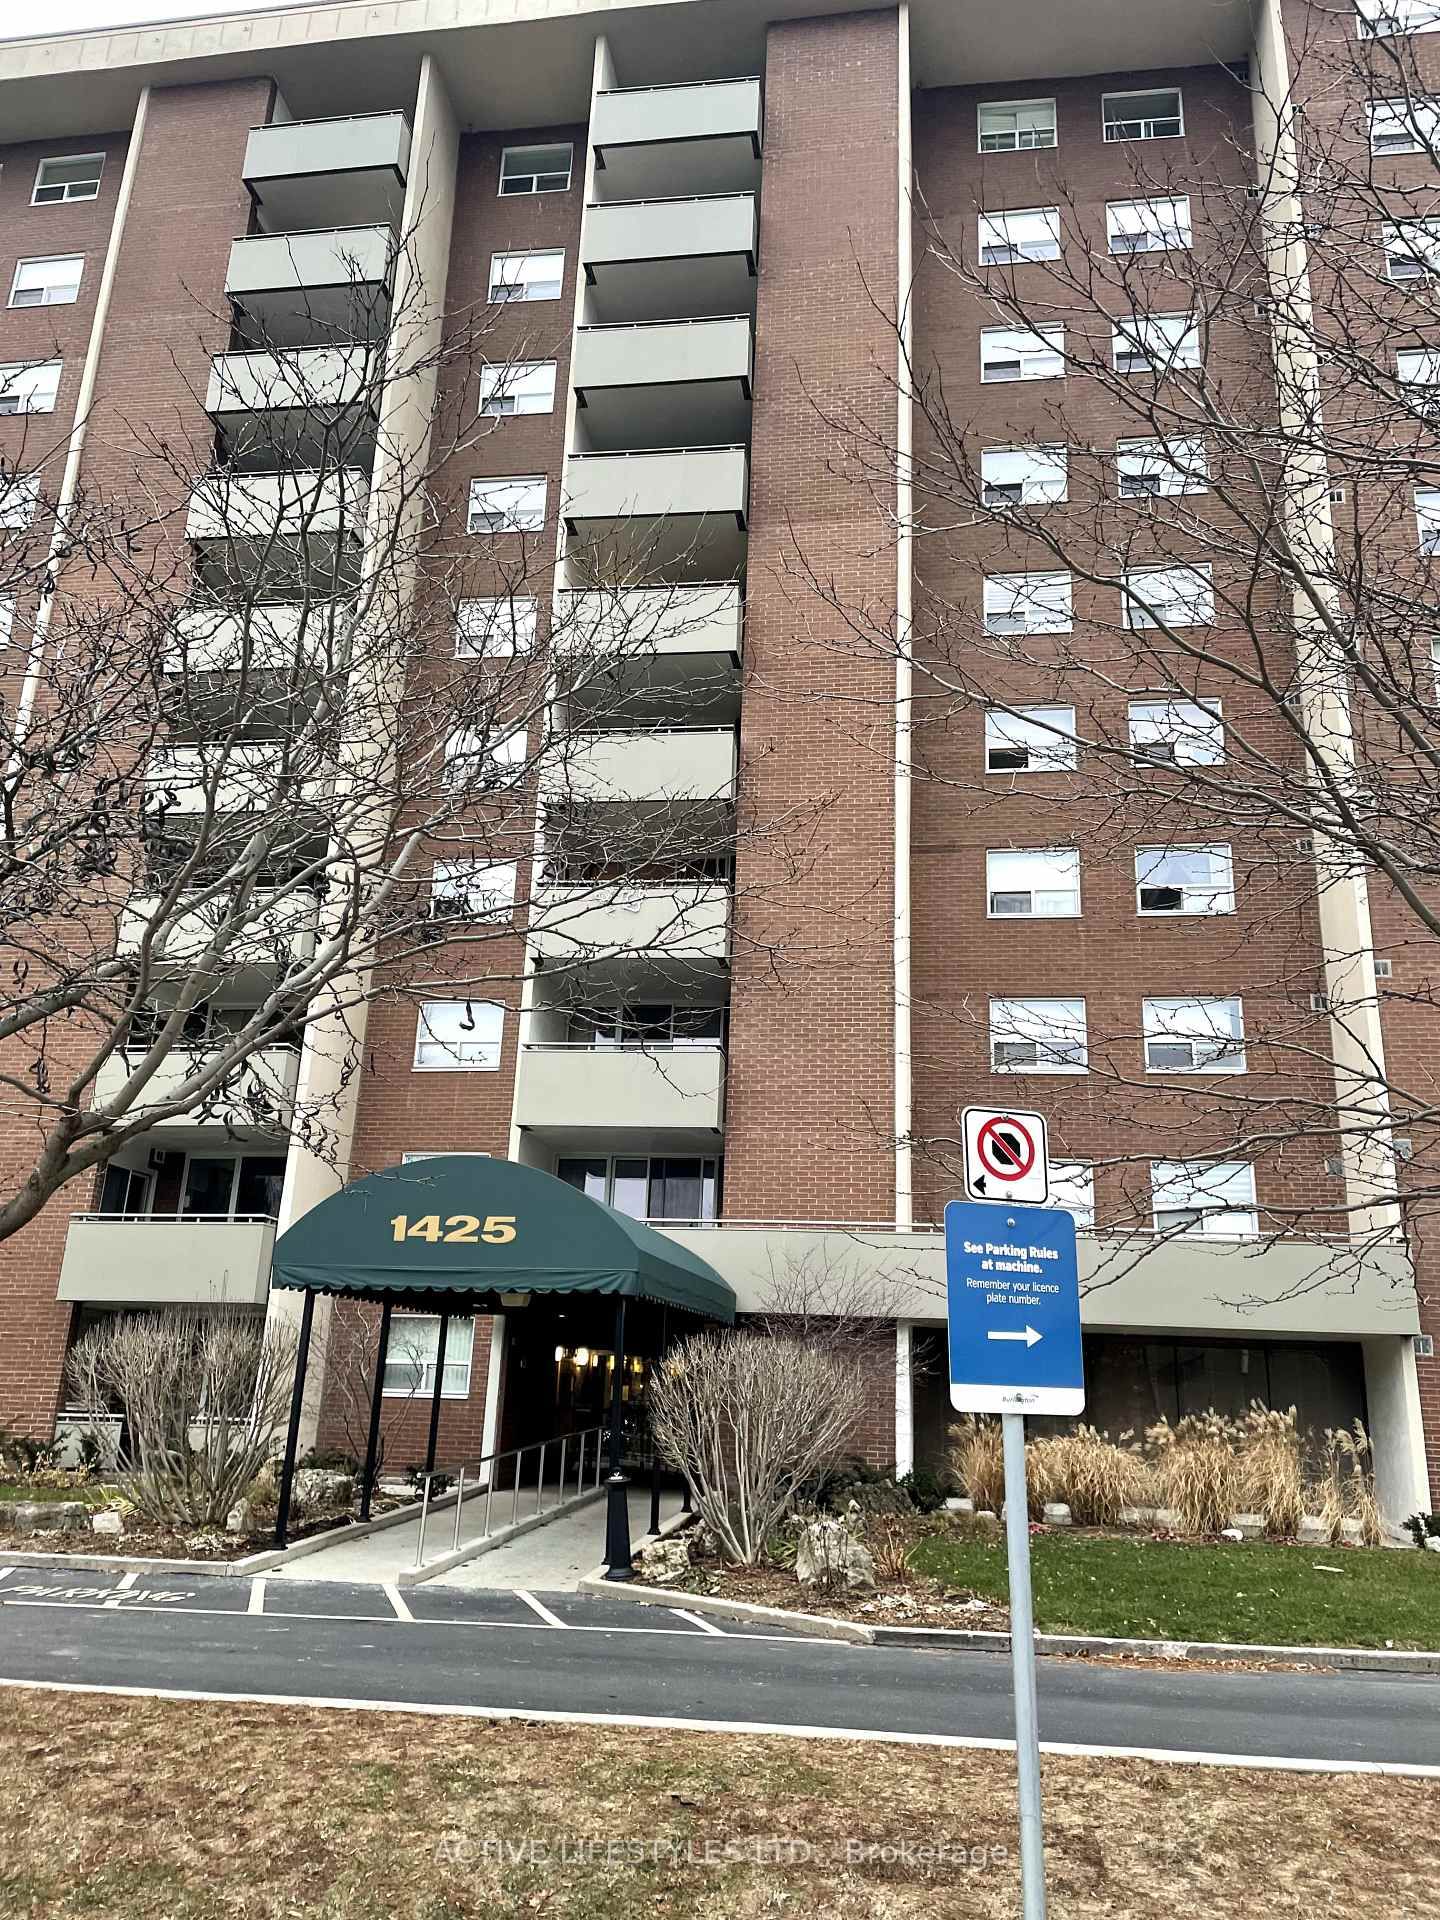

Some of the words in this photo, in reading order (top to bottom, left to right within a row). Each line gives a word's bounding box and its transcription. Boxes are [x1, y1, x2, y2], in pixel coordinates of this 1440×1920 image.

[390, 1215, 517, 1244] 1425
[963, 1241, 984, 1254] See
[985, 1243, 1028, 1260] Parking
[1029, 1246, 1059, 1260] Rules
[981, 1259, 994, 1270] at
[995, 1260, 1044, 1274] machine.
[966, 1277, 1010, 1291] Remember
[1012, 1282, 1031, 1293] your
[1032, 1281, 1060, 1294] licence
[986, 1292, 1007, 1305] plate
[1008, 1294, 1042, 1306] number.
